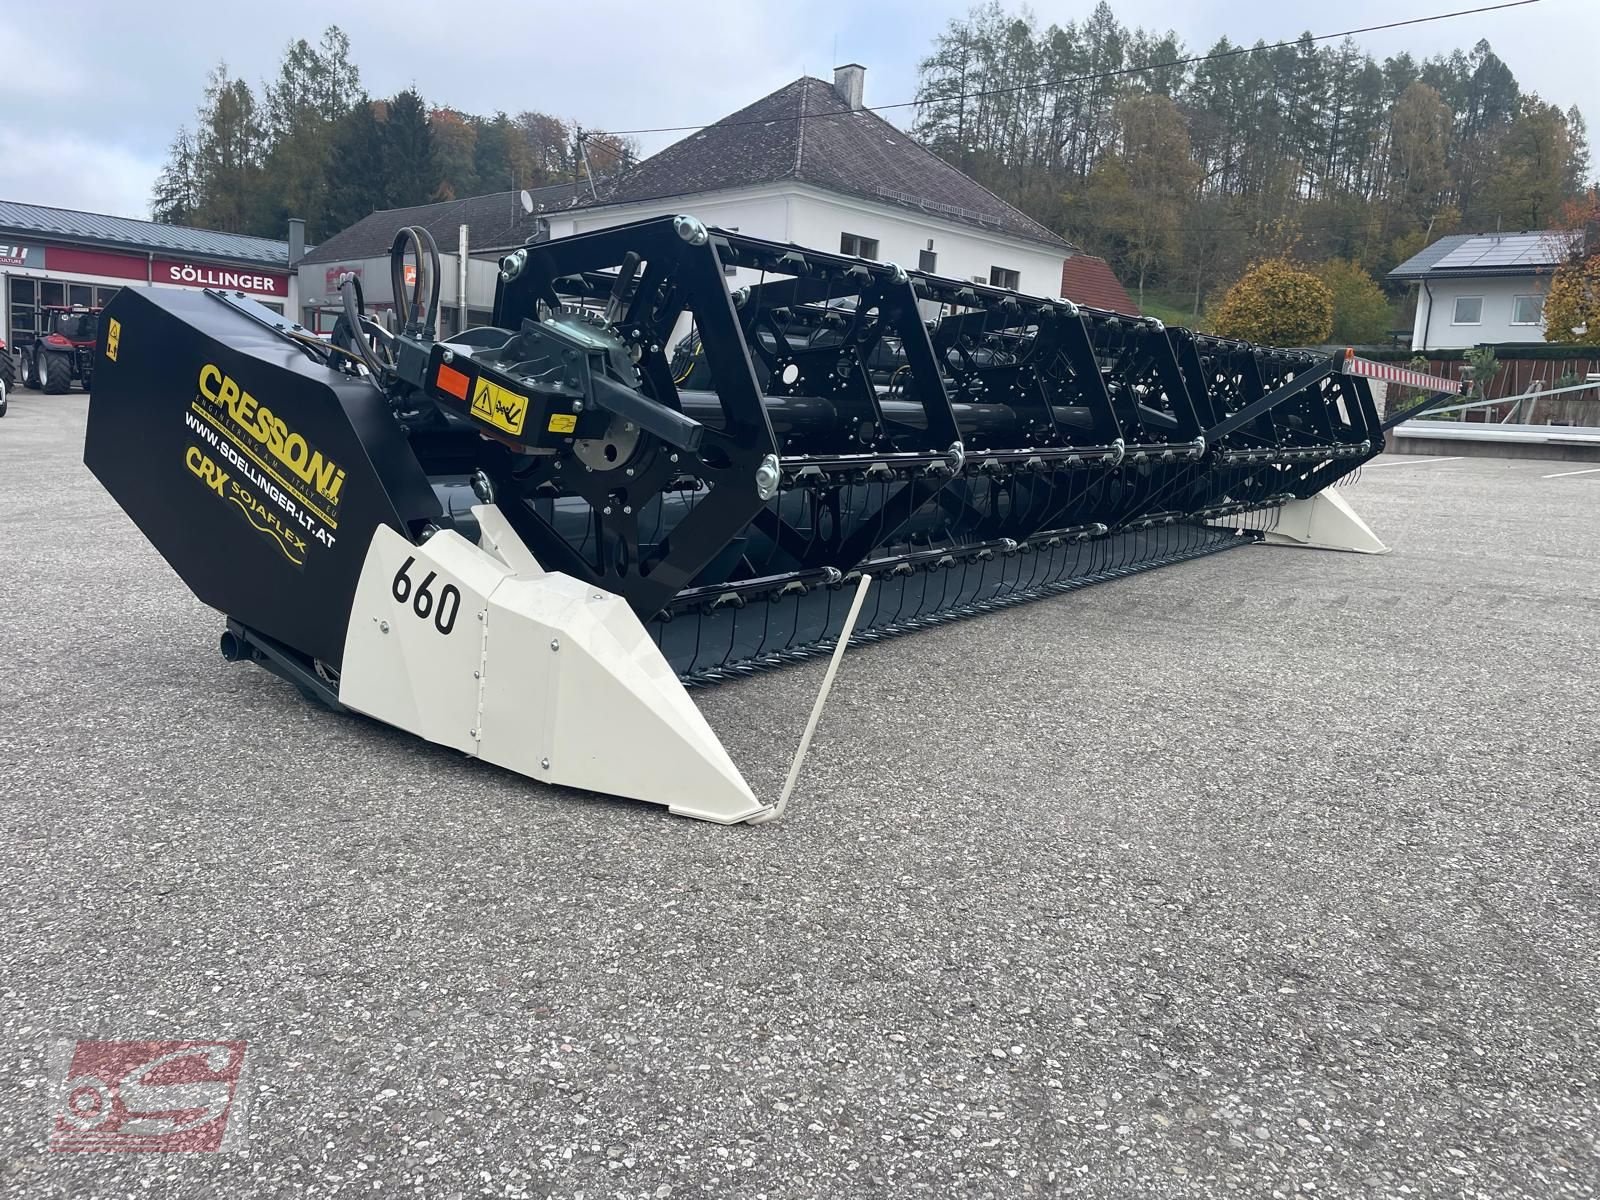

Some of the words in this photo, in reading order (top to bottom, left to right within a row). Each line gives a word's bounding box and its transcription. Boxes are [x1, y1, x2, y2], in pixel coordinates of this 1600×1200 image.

[170, 264, 275, 291] SÖLLINGER
[185, 411, 336, 548] WWW.SOELLINGER-LT.AT
[186, 446, 230, 498] CRX
[195, 394, 260, 453] ENGINEERING
[291, 477, 315, 499] ITALY
[326, 505, 337, 518] EU
[231, 481, 306, 554] SOJAFLEX
[392, 555, 461, 635] 660
